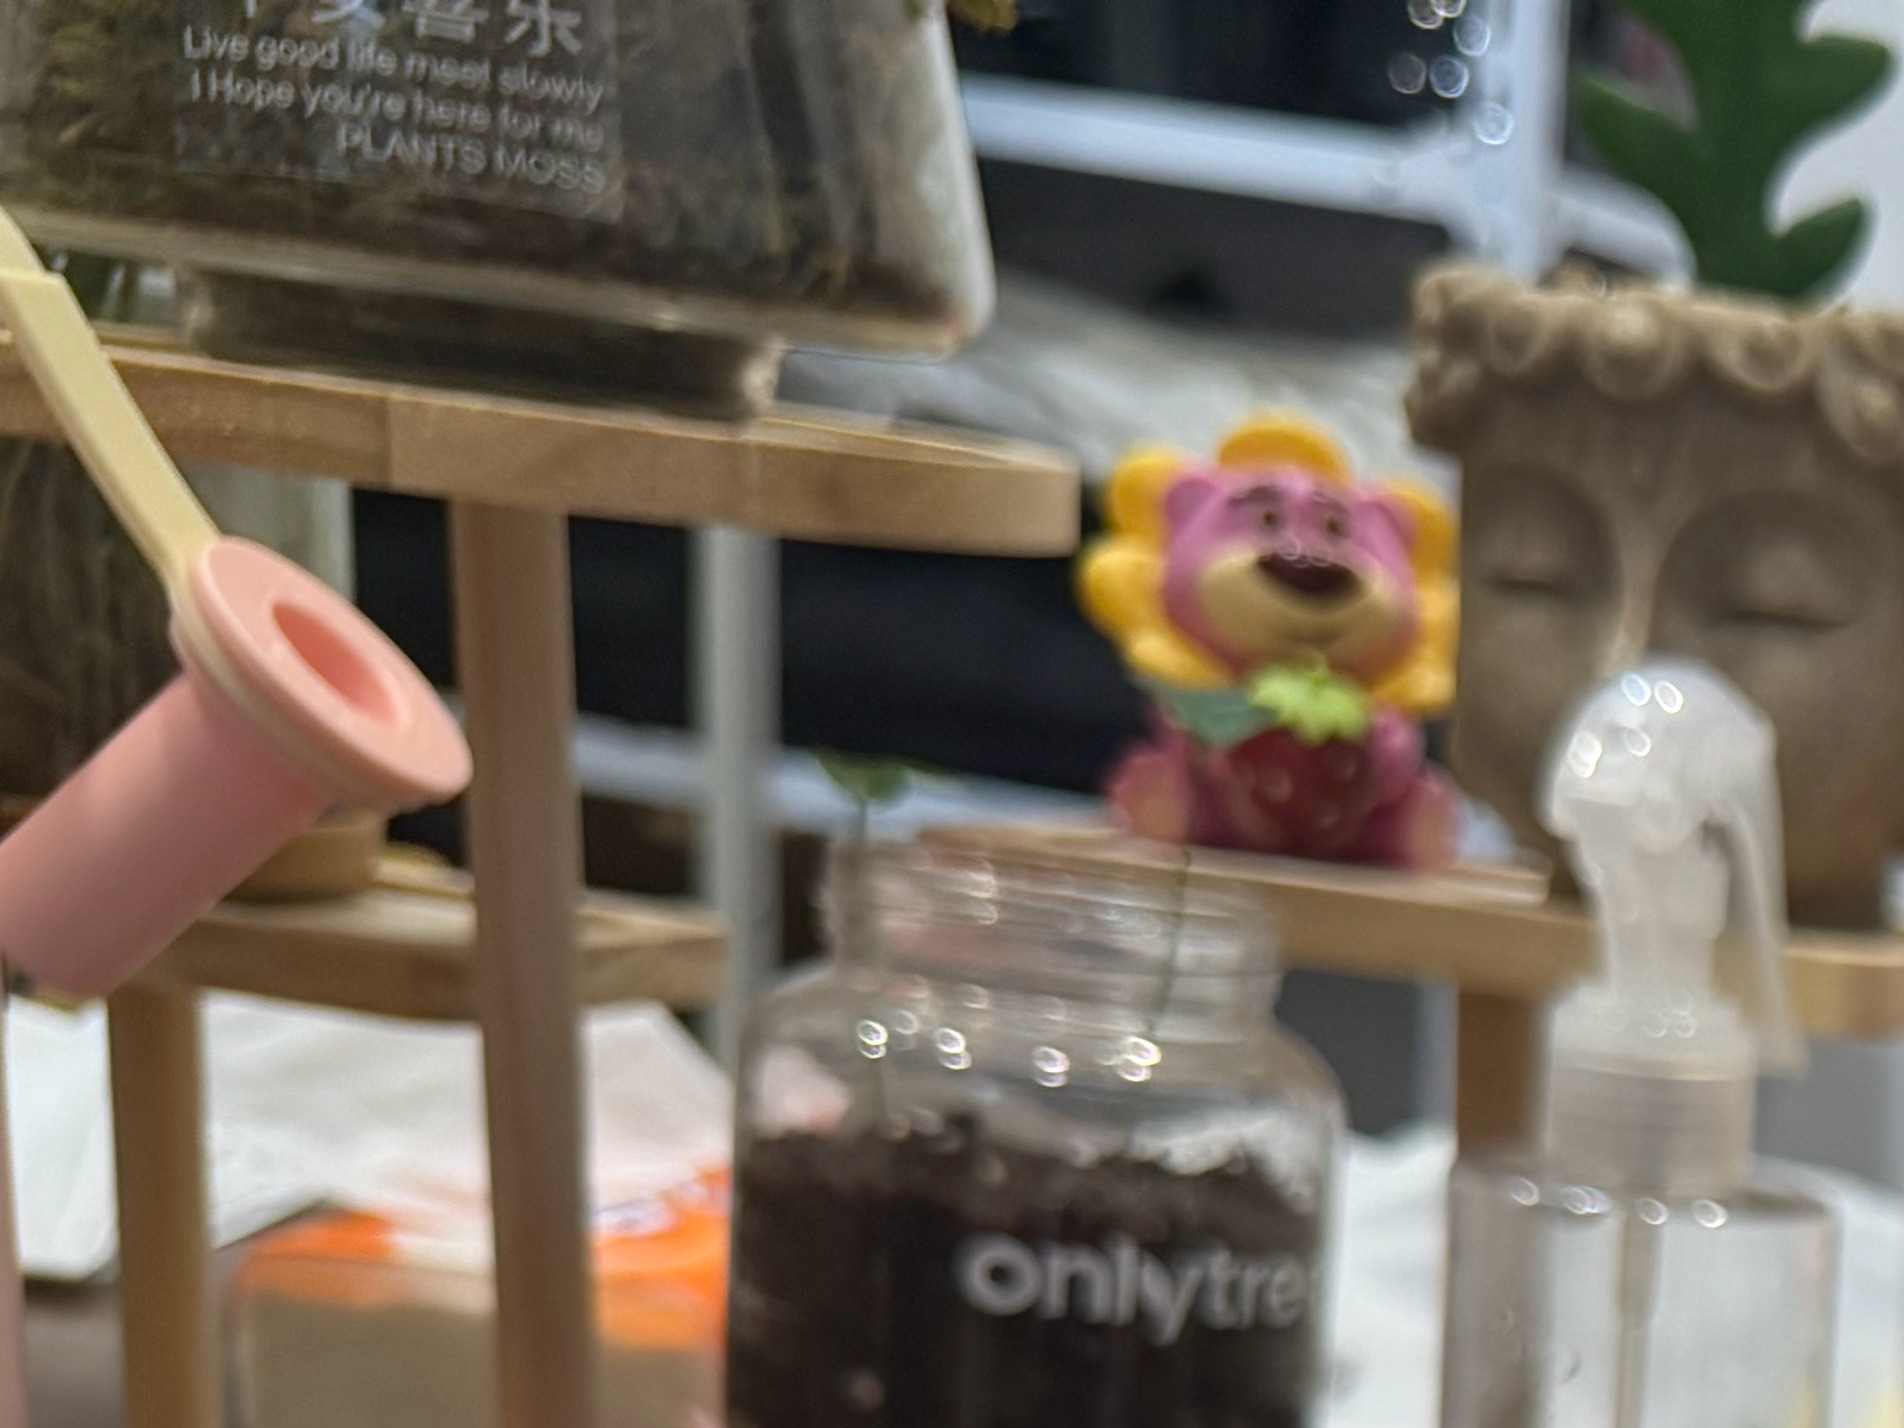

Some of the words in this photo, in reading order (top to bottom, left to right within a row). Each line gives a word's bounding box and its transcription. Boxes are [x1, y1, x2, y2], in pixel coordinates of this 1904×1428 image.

[183, 24, 249, 61] Live
[255, 36, 338, 71] good
[347, 39, 397, 75] life
[500, 62, 604, 115] slowly
[208, 69, 294, 112] Hope
[304, 82, 406, 119] you're
[411, 90, 491, 129] here
[499, 104, 541, 139] for
[338, 123, 486, 175] PLANTS
[494, 145, 606, 193] MOSS
